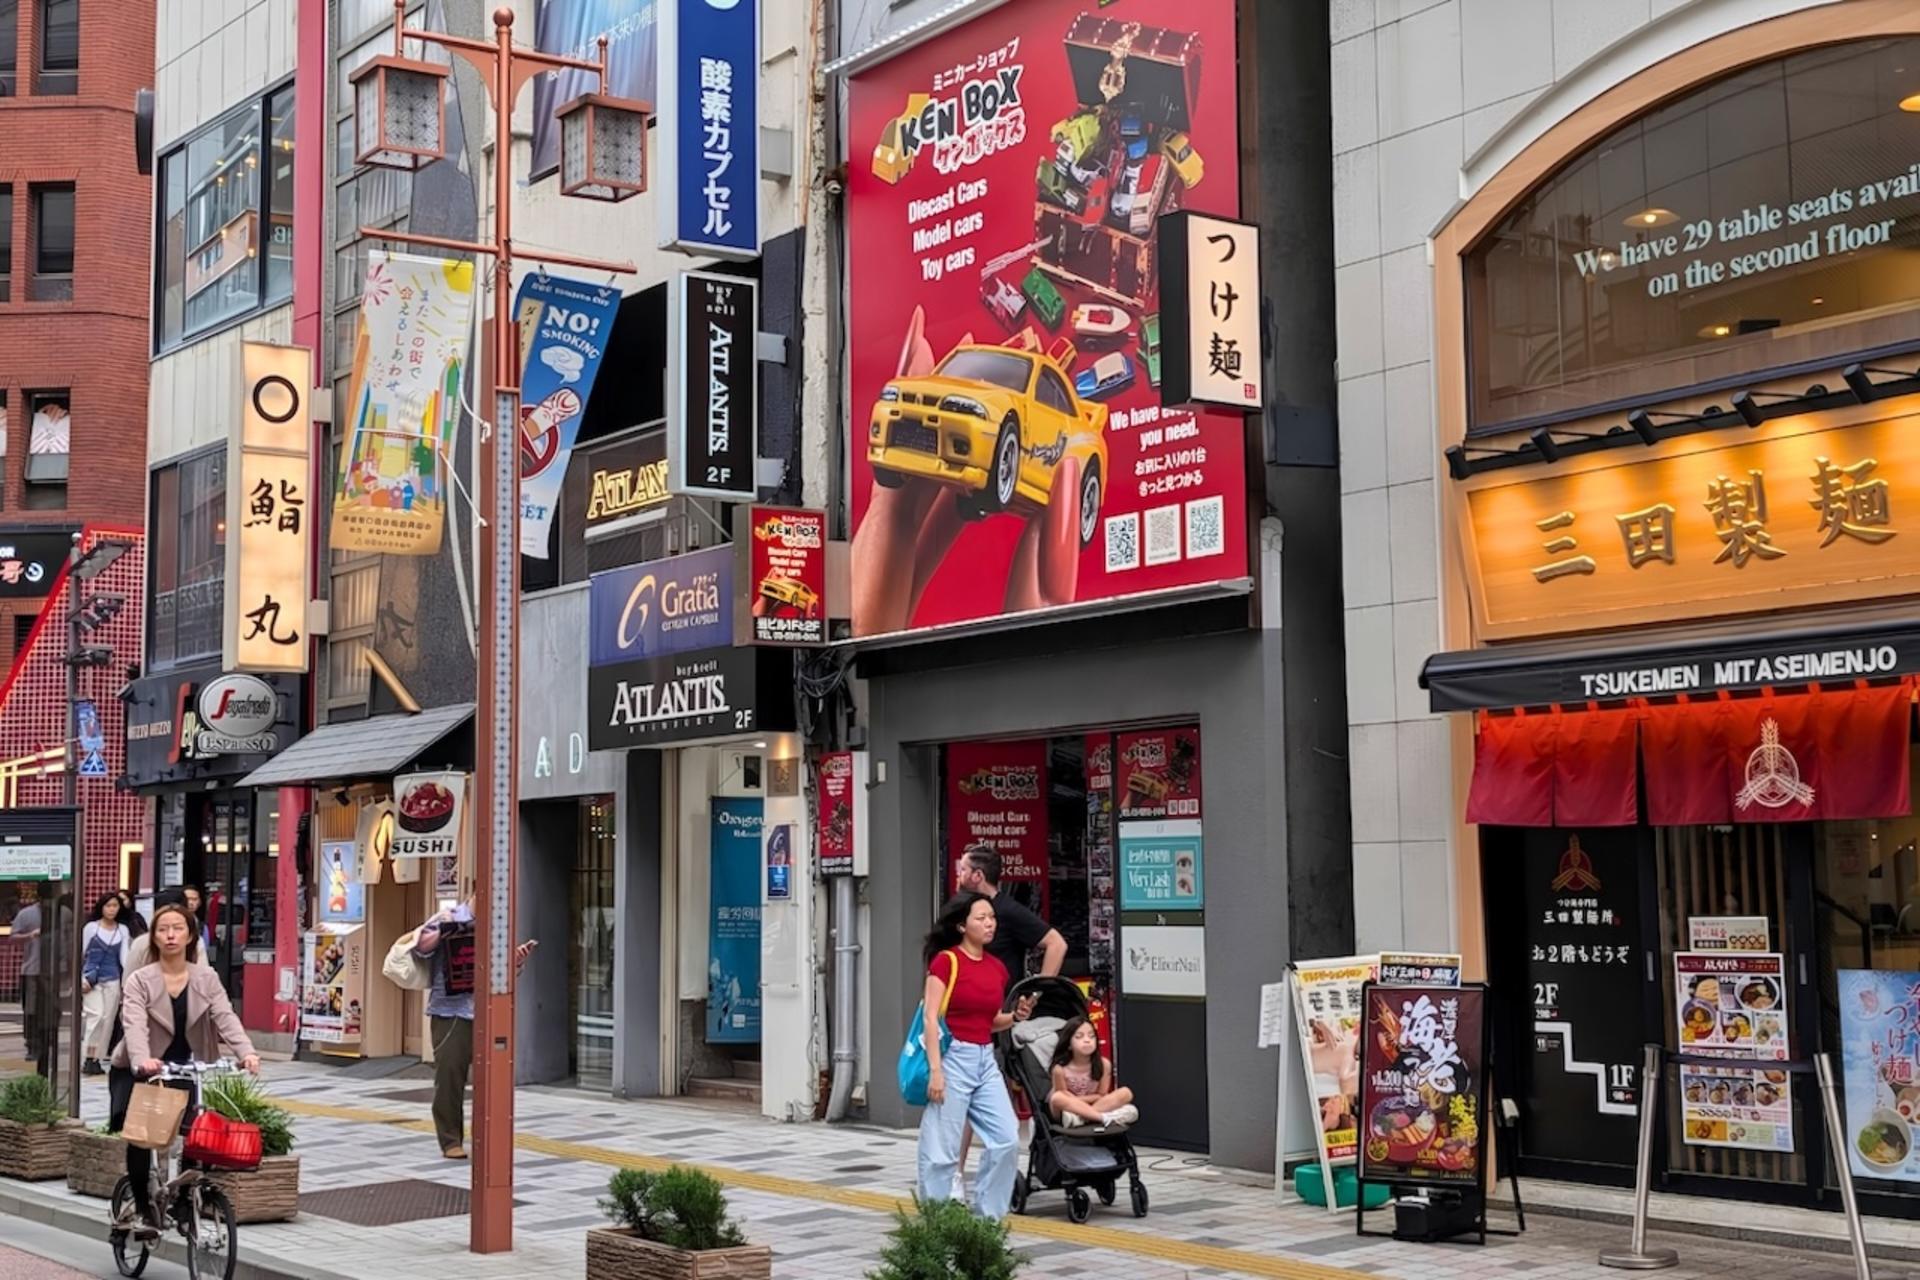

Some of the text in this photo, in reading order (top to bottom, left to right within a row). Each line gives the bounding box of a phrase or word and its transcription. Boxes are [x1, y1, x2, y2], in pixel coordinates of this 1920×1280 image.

[933, 37, 1020, 91] ミニカーショップ
[900, 67, 1021, 156] KEN BOX
[700, 57, 733, 238] 酸素カプセル
[908, 178, 987, 224] Diecast Cars
[913, 212, 984, 253] Model cars
[1573, 166, 1920, 278] We have 29 table seats avai
[921, 247, 975, 281] Toy cars
[1648, 218, 1896, 298] on the second floor
[706, 283, 733, 298] buy
[544, 305, 600, 336] NO!
[706, 304, 735, 317] sell
[1208, 232, 1242, 381] つけ麺
[541, 328, 600, 359] SMOKING
[709, 321, 732, 456] ATLANTIS
[1110, 411, 1128, 431] We
[1131, 406, 1159, 427] have
[1140, 417, 1199, 451] you need.
[707, 467, 731, 484] 2F
[1135, 447, 1207, 477] お気に入りの1台
[1138, 470, 1204, 498] きっと見つかる
[768, 524, 791, 537] KEN
[1531, 455, 1898, 584] 三田製麺
[661, 581, 719, 617] Gratia
[1580, 646, 1897, 696] TSUKEMEN MITASEIMENJO
[609, 675, 730, 726] ATLANTIS
[735, 710, 752, 729] 2F
[975, 774, 1034, 788] KEN BOX
[971, 825, 1027, 835] Model cars
[1007, 811, 1030, 822] Cars
[391, 839, 454, 855] SUSHI
[998, 839, 1020, 848] cars
[1532, 944, 1629, 964] お2階もどうぞ
[1534, 983, 1559, 1005] 2F
[1884, 1004, 1913, 1086] つけ麺
[1609, 1064, 1635, 1088] 1F
